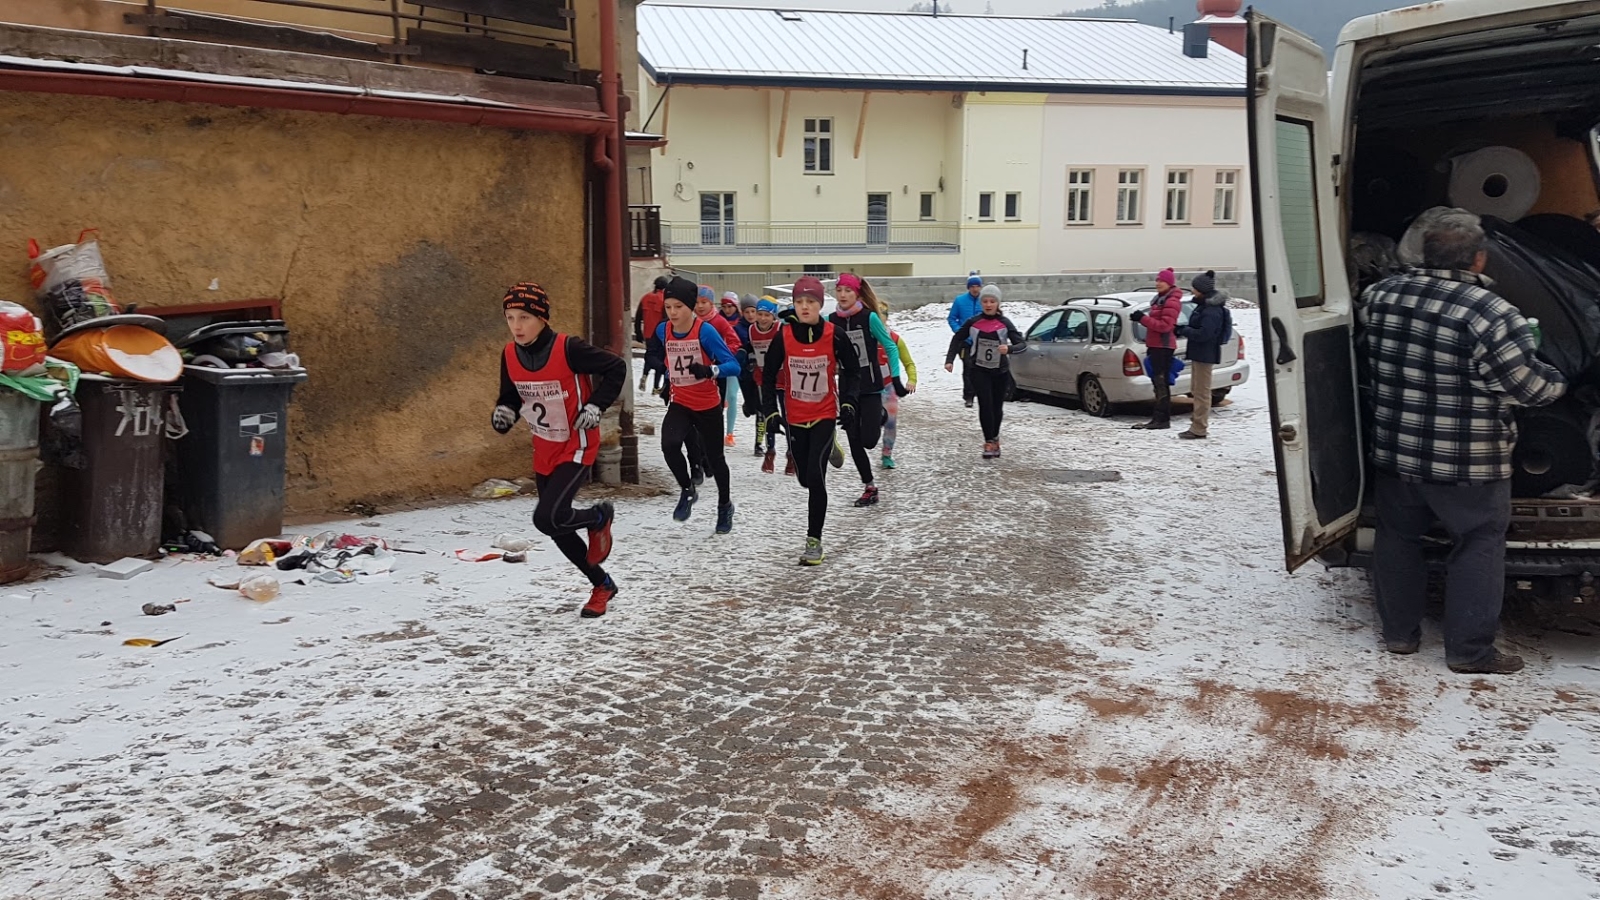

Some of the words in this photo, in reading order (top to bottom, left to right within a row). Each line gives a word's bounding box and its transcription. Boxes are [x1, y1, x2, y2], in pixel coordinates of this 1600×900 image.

[985, 348, 993, 361] 6
[674, 355, 694, 376] 47
[797, 371, 820, 392] 77
[543, 389, 560, 397] LIGA
[532, 402, 550, 428] 2
